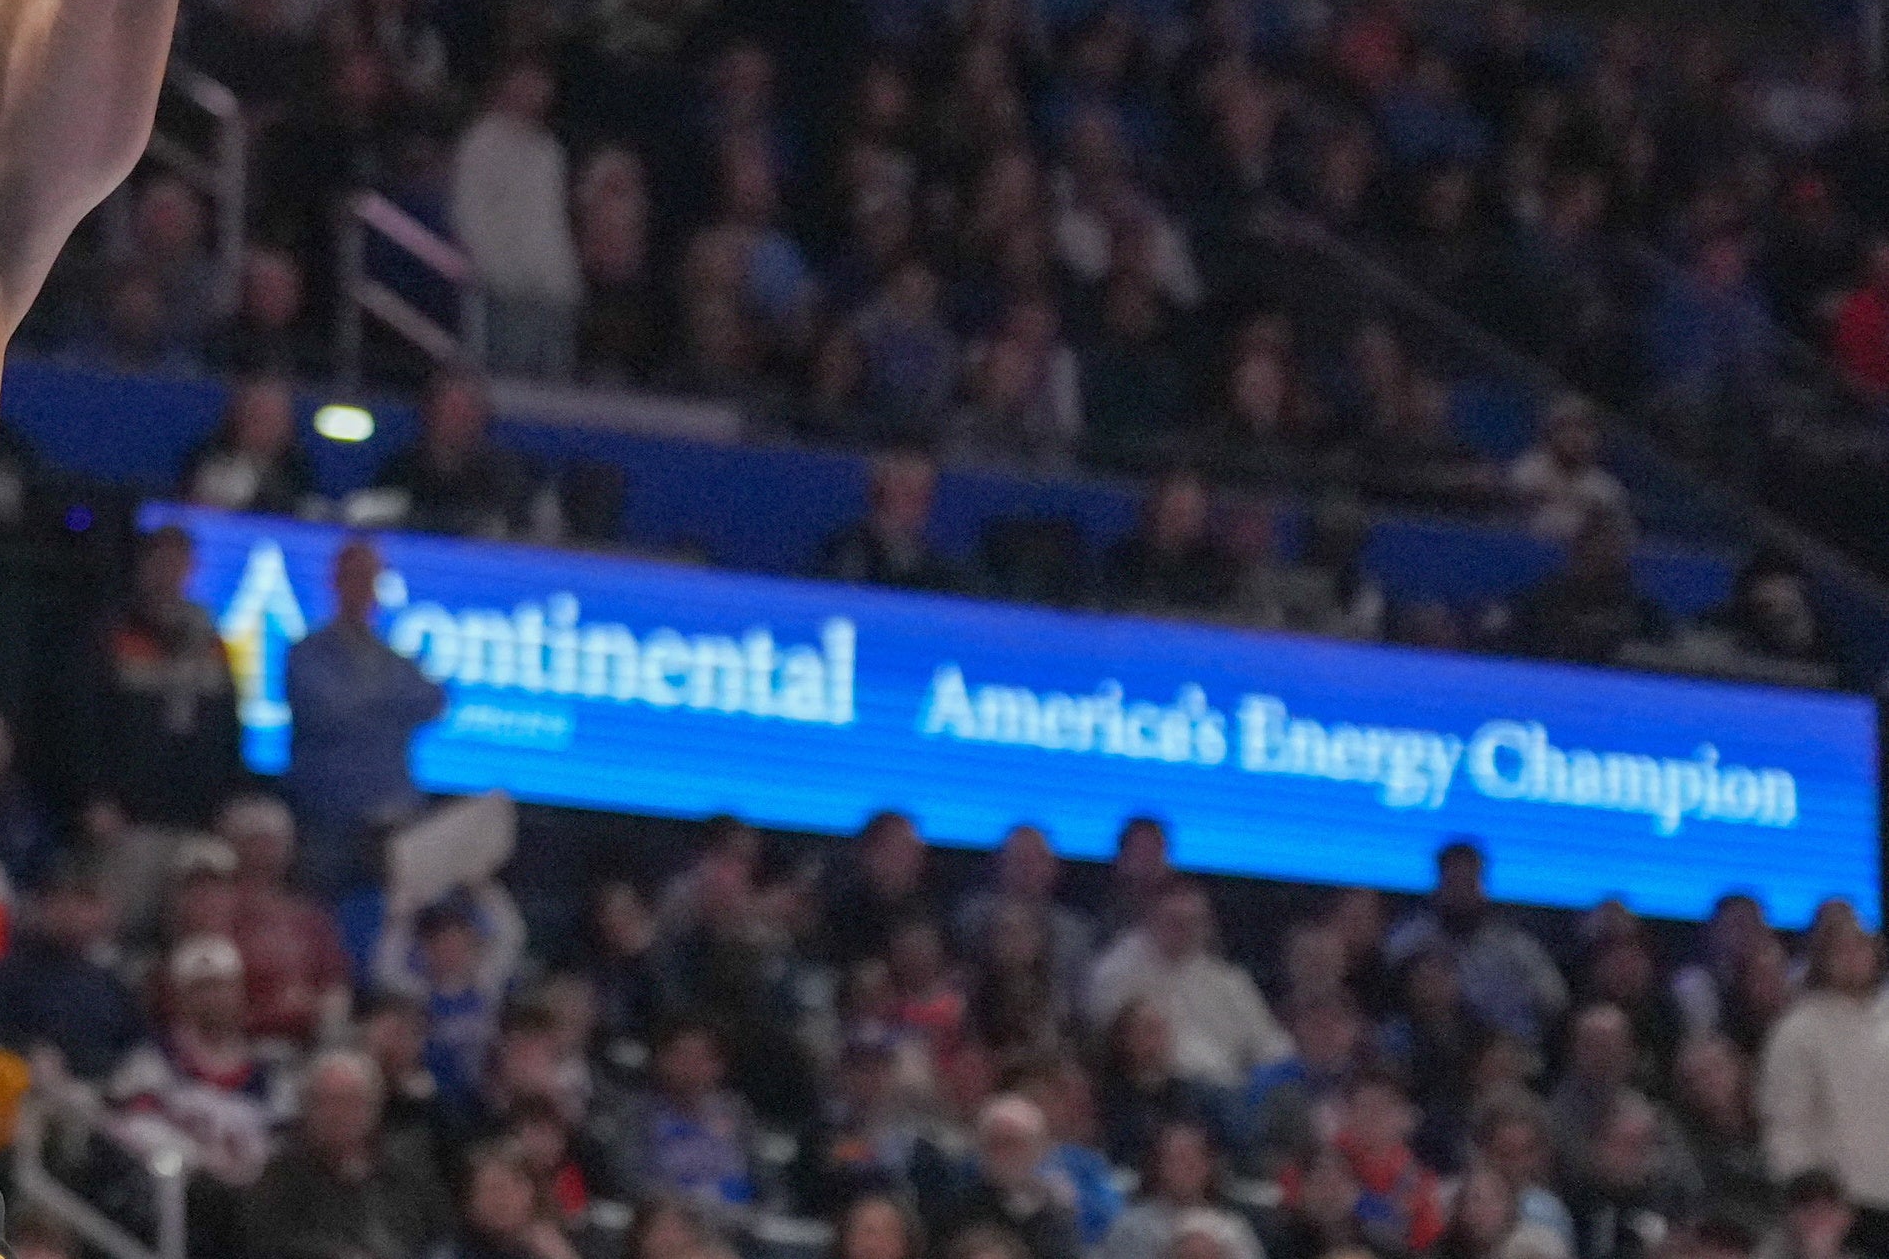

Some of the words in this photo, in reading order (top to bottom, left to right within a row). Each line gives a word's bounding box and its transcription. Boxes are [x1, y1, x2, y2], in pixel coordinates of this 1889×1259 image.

[921, 663, 1227, 766] America's
[1238, 693, 1464, 810] Energy
[1468, 719, 1798, 837] Champion
